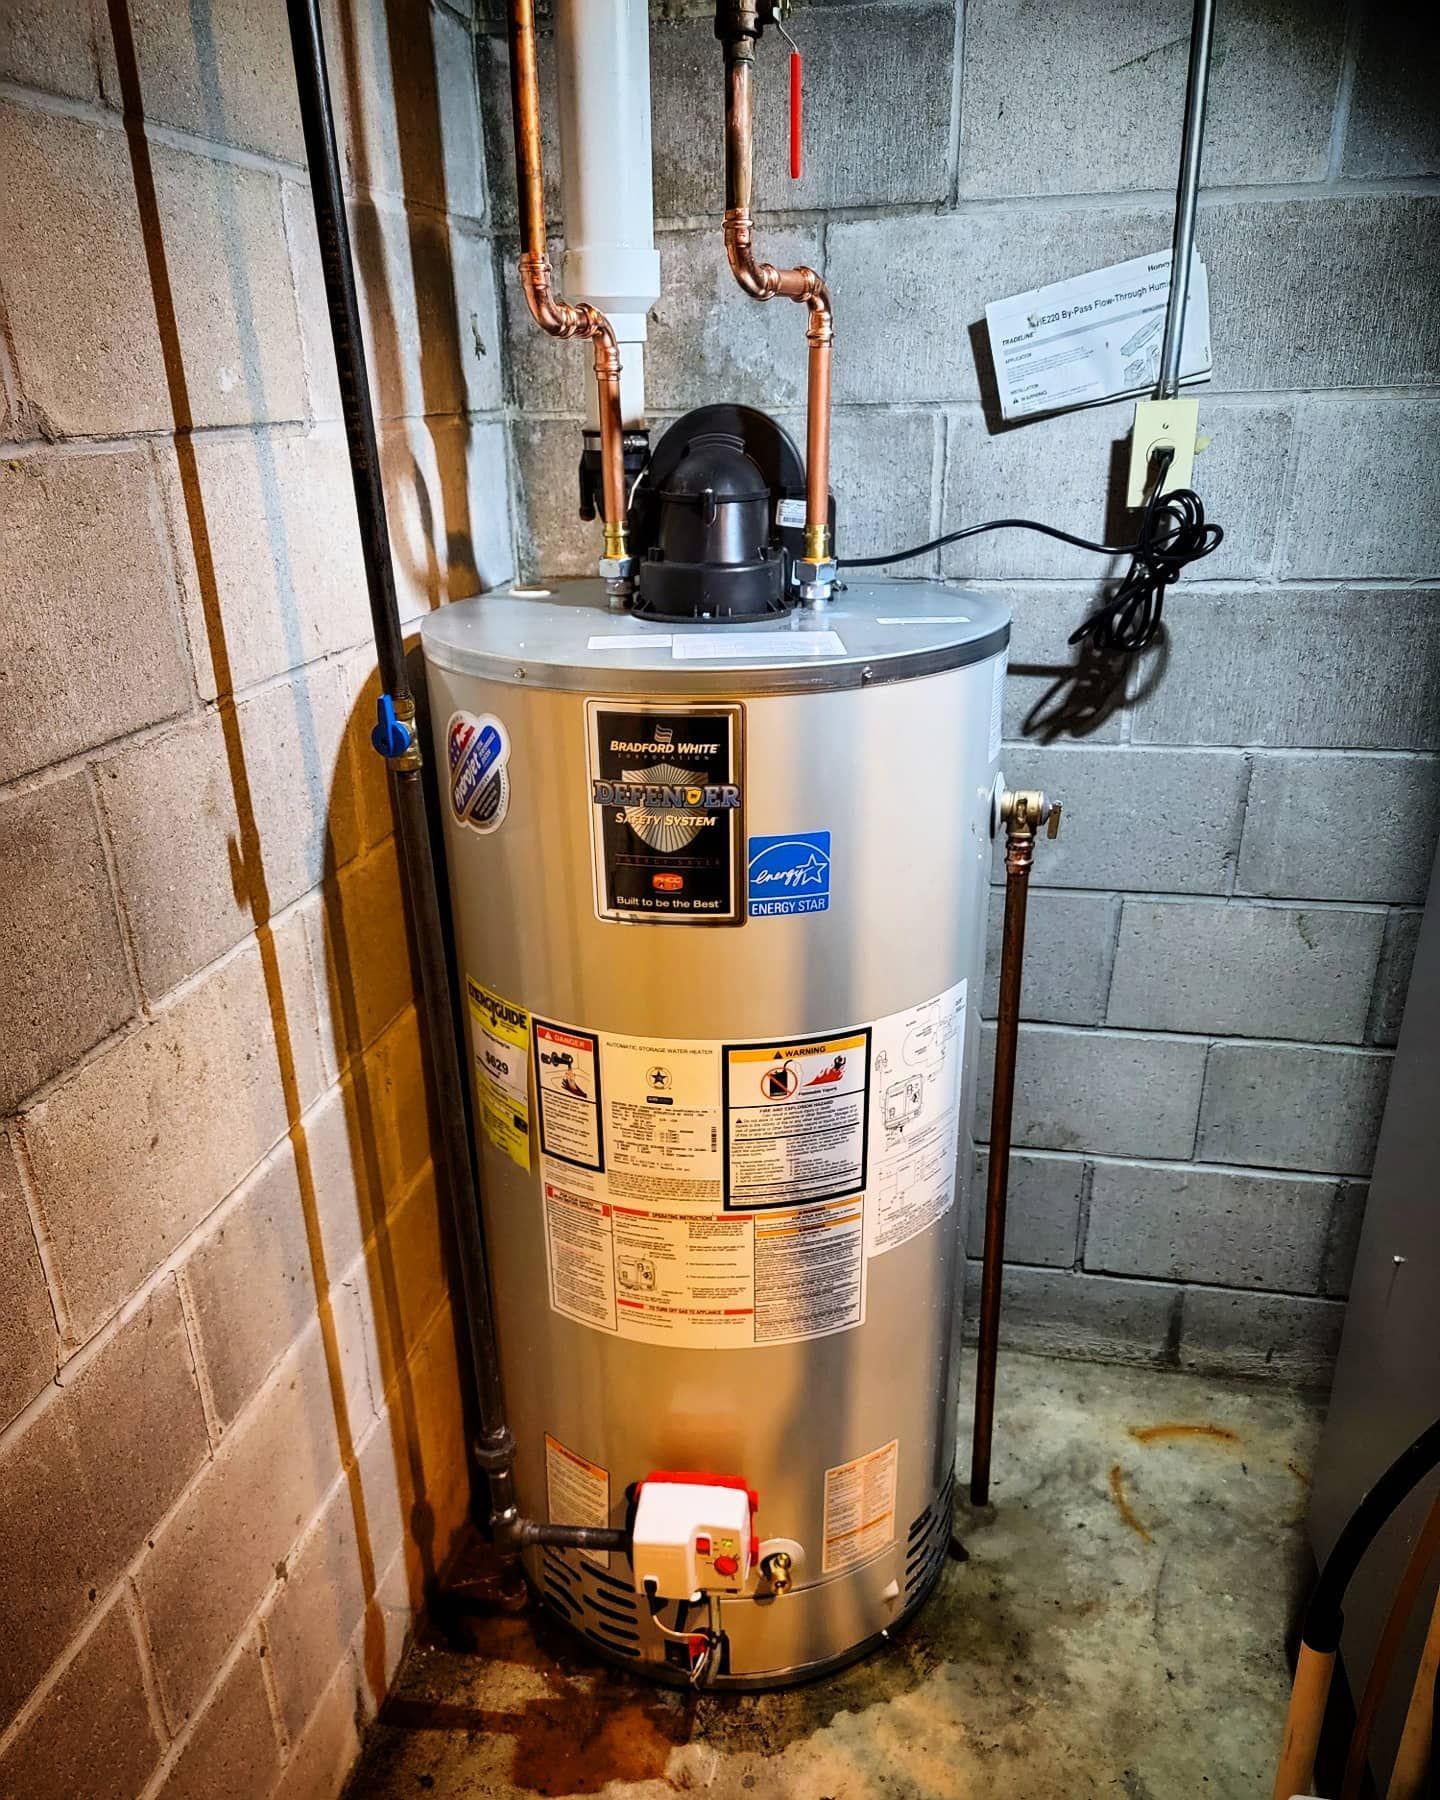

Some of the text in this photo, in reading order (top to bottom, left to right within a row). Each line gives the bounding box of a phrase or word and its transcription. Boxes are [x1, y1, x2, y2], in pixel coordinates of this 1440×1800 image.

[1061, 303, 1094, 320] By-Pass
[1094, 284, 1148, 309] Flow-Through
[610, 740, 718, 755] BRADFORD WHITE
[593, 779, 741, 809] DEFENDER
[615, 812, 716, 827] SAFETY SYSTEM
[617, 896, 720, 909] Built to be the Best
[752, 899, 825, 915] ENERGY STAR
[785, 1045, 826, 1058] WARNING
